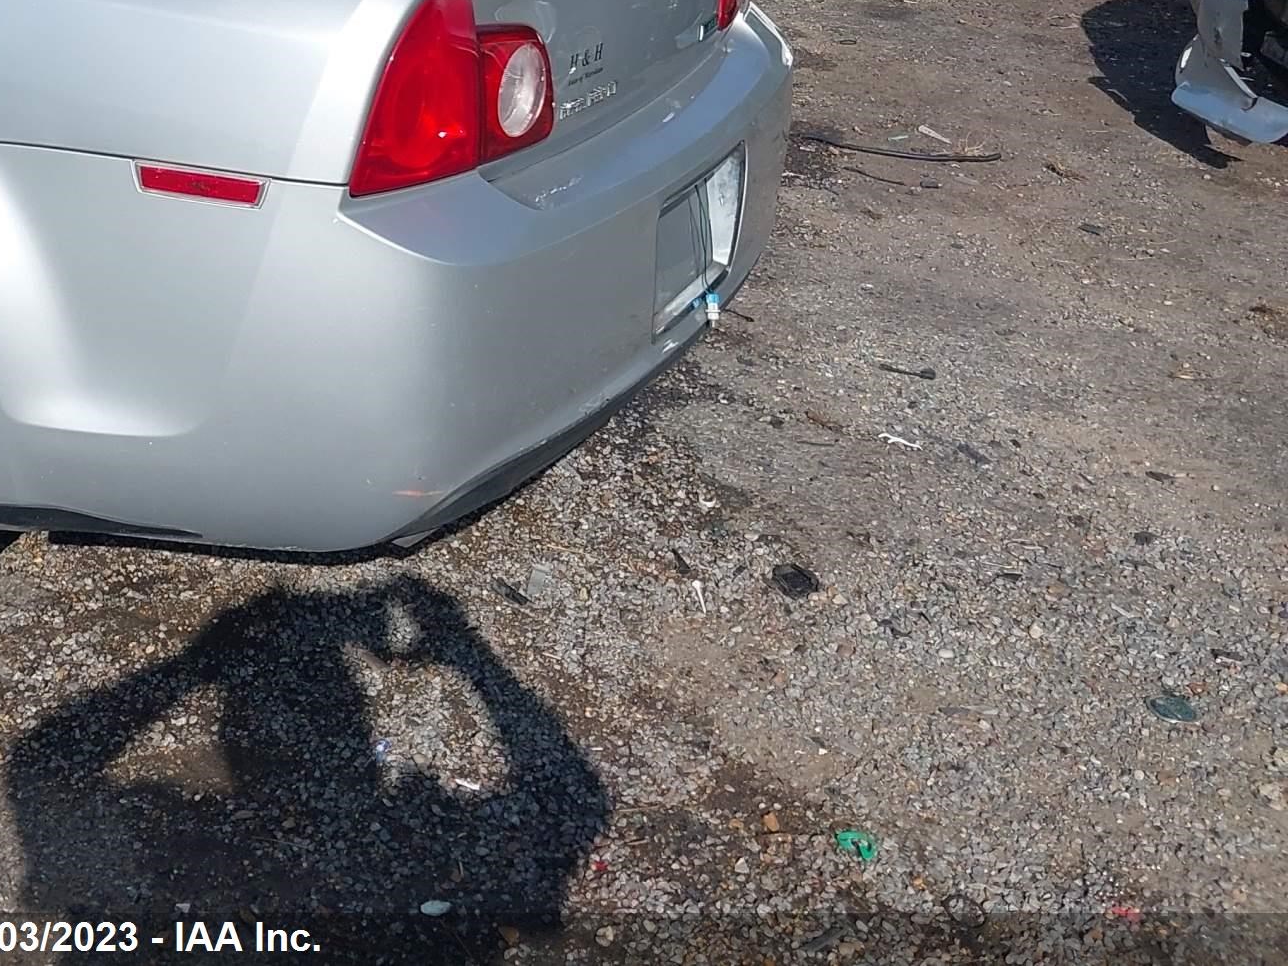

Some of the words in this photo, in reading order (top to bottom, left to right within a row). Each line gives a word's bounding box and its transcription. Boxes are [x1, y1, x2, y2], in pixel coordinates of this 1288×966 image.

[569, 53, 579, 68] H
[581, 49, 590, 67] &
[593, 42, 604, 61] H
